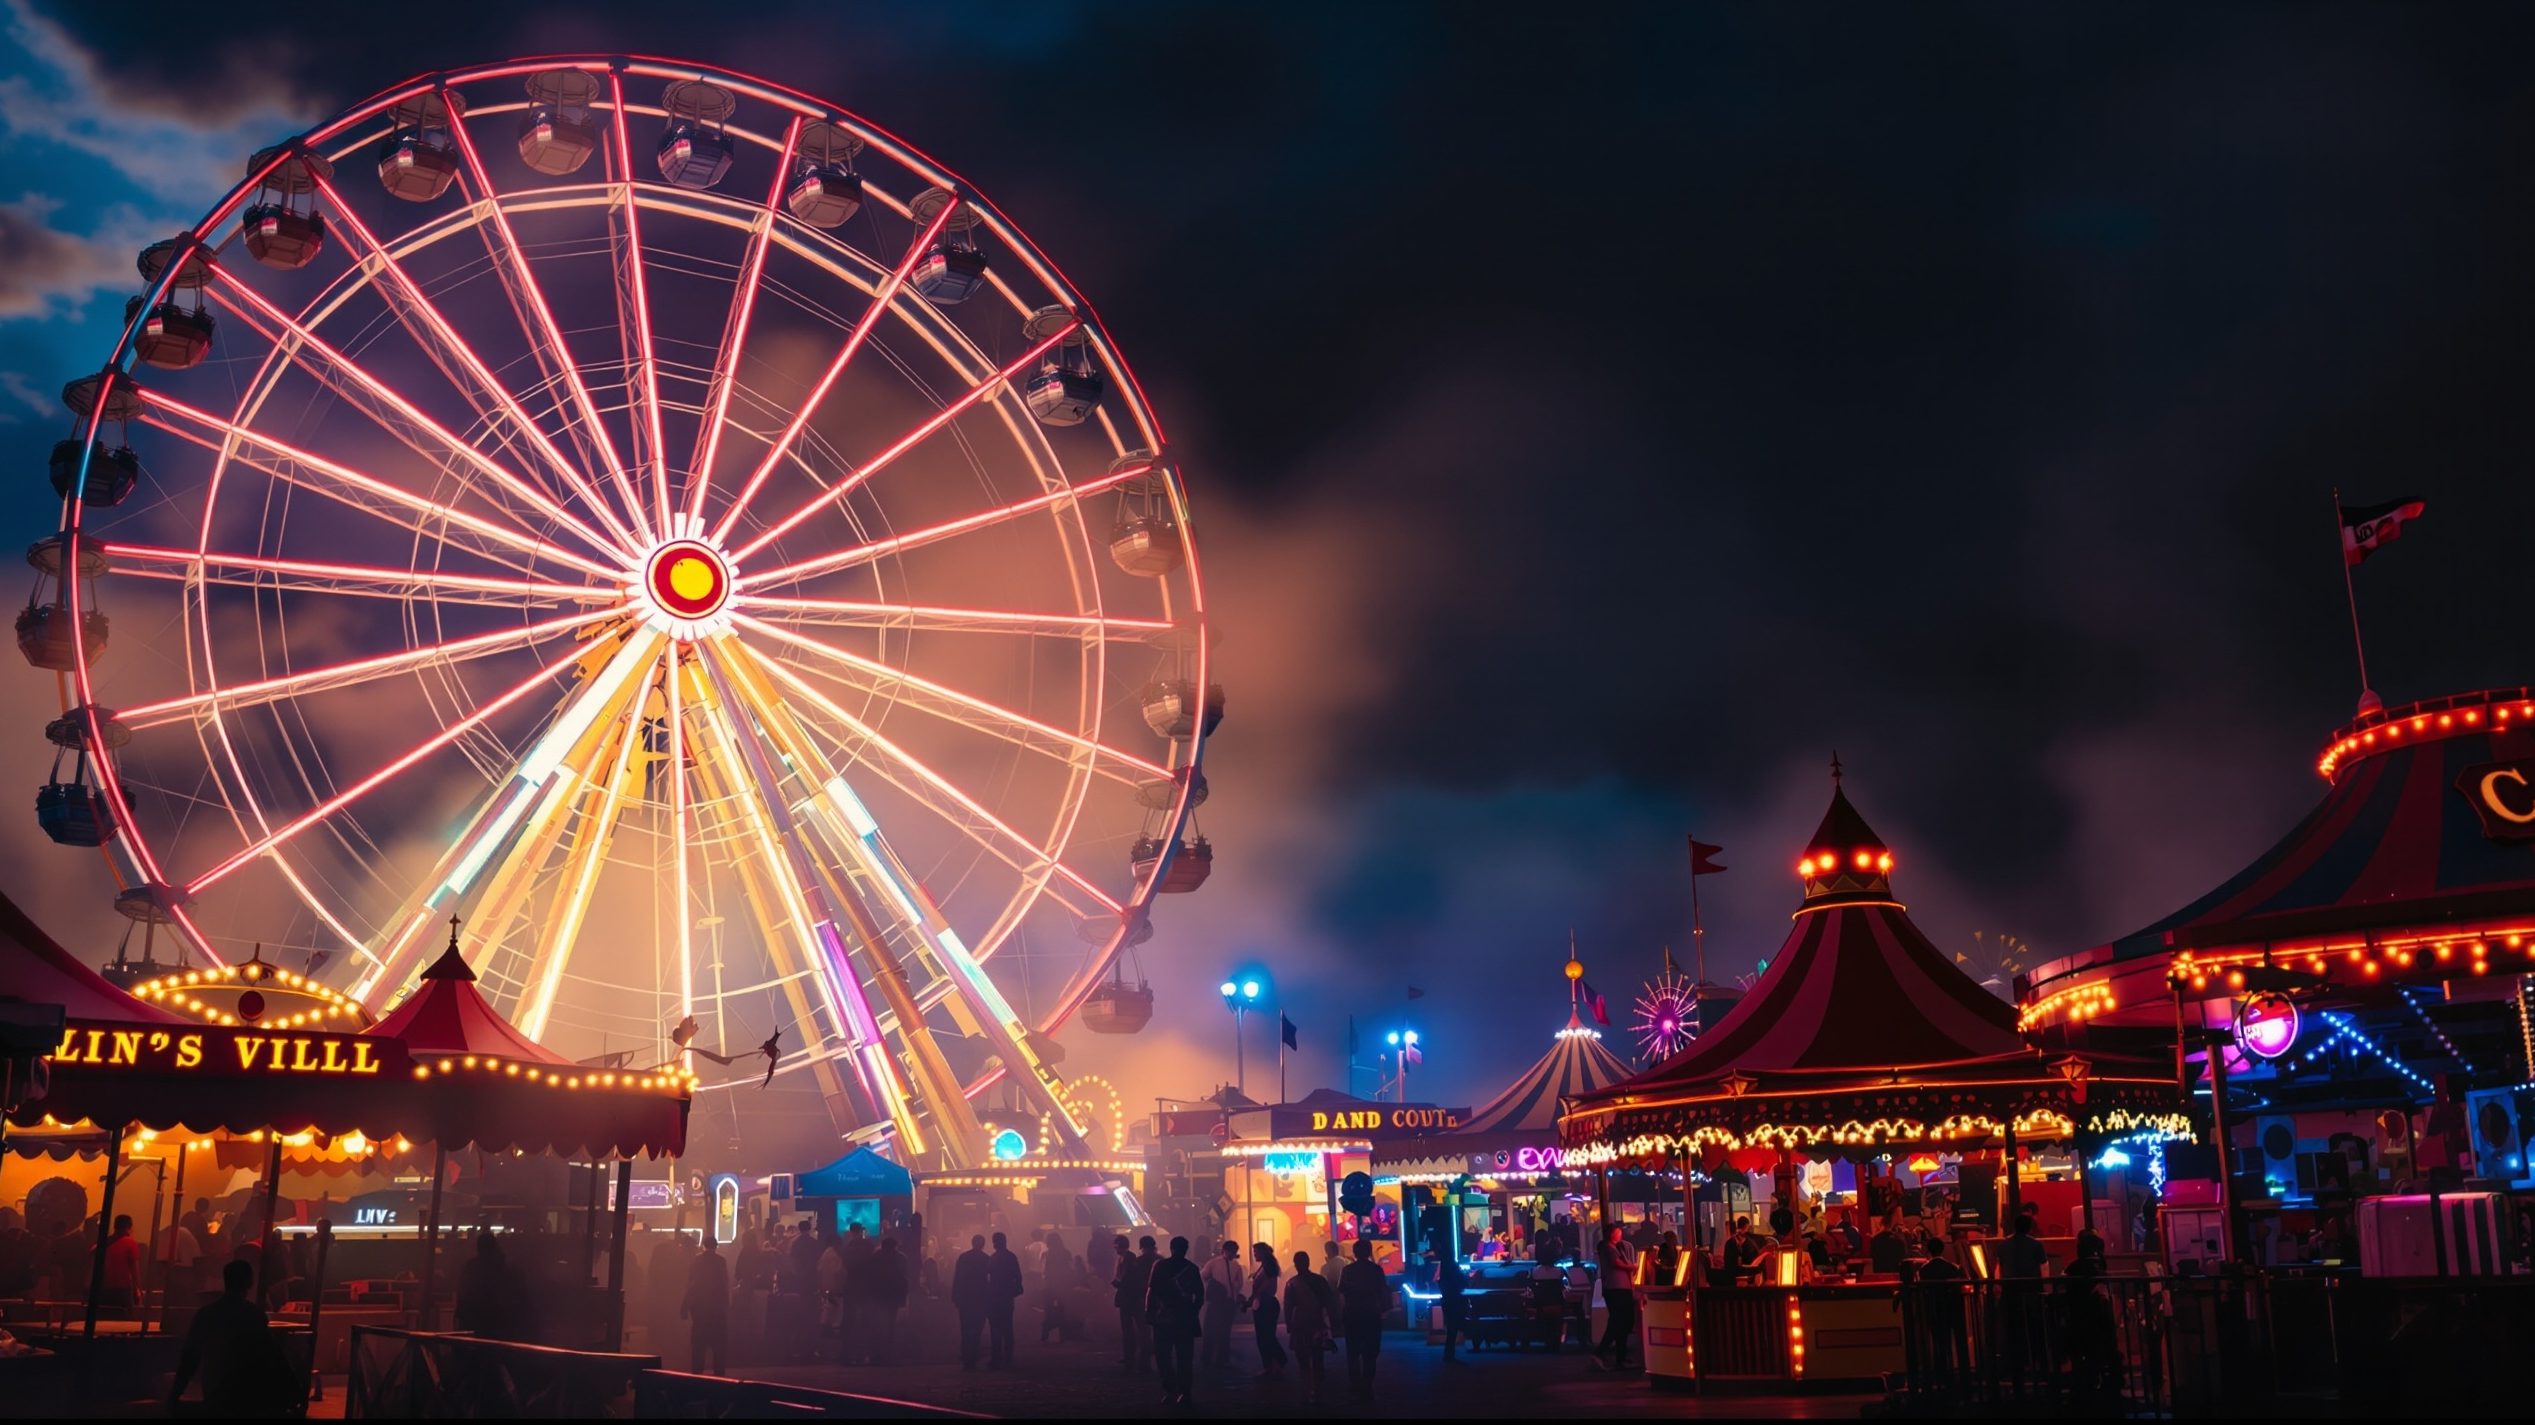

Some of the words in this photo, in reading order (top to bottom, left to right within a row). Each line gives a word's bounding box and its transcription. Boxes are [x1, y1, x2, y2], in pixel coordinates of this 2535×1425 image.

[234, 1036, 380, 1073] VILLL
[1312, 1112, 1328, 1130] D
[1332, 1111, 1382, 1129] AND
